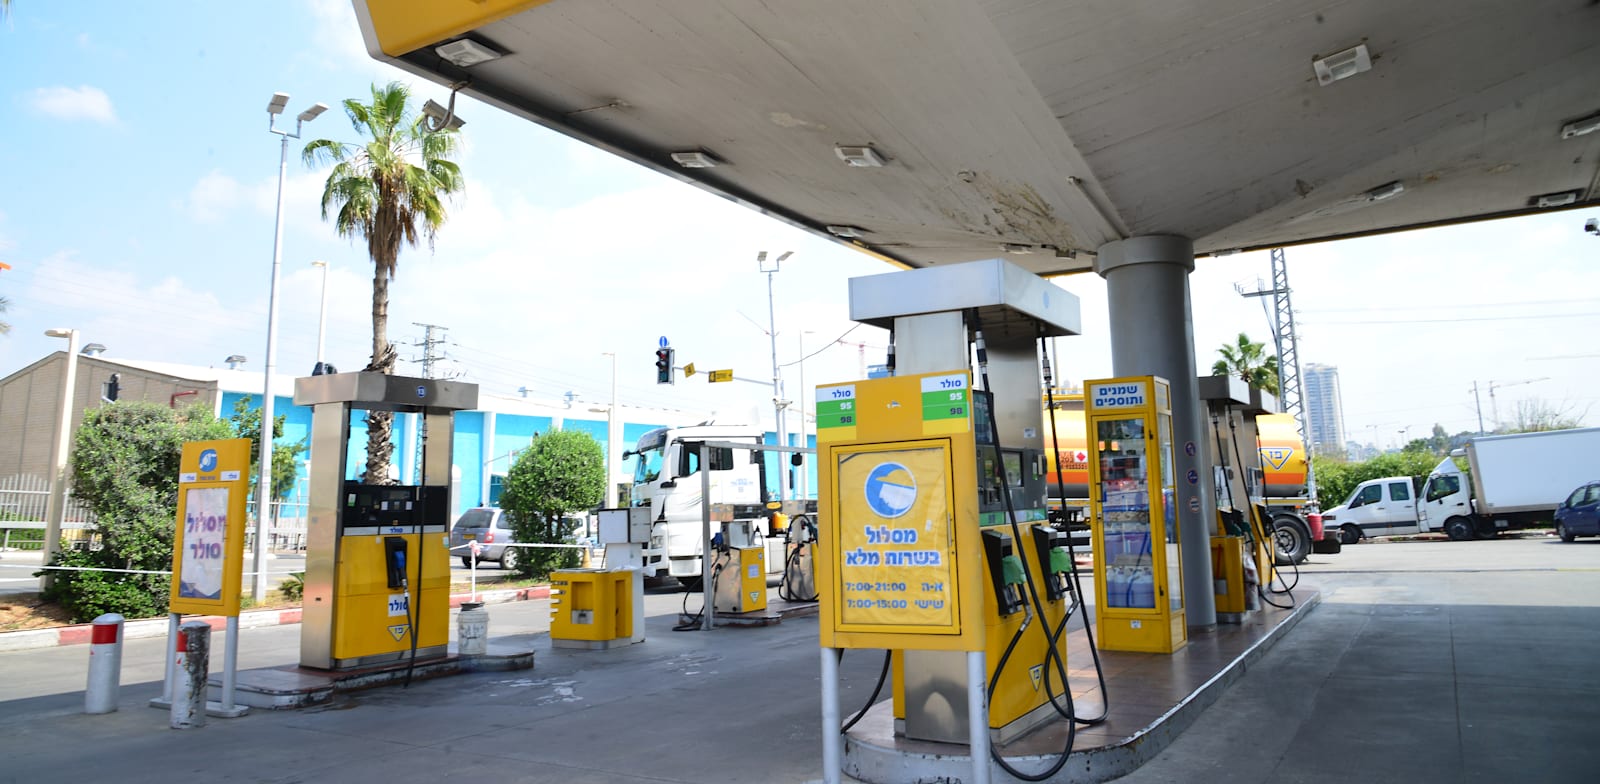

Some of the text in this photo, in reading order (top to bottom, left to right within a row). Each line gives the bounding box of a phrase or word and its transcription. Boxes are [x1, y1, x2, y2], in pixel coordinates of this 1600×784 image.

[940, 379, 962, 389] סולר
[832, 389, 851, 398] סולר
[1099, 385, 1138, 396] שמנים
[949, 392, 963, 401] 95
[1095, 396, 1143, 407] ותוספים
[840, 402, 853, 410] 95
[950, 407, 963, 416] 98
[840, 416, 853, 424] 98
[1269, 450, 1283, 460] פז
[865, 525, 917, 544] מסלול
[190, 538, 222, 560] סולר
[845, 547, 941, 566] בשרות מלא
[845, 582, 944, 592] א-ה 7:00-21:00
[389, 600, 408, 611] סולר
[847, 599, 945, 609] שישי 7:00-15:00
